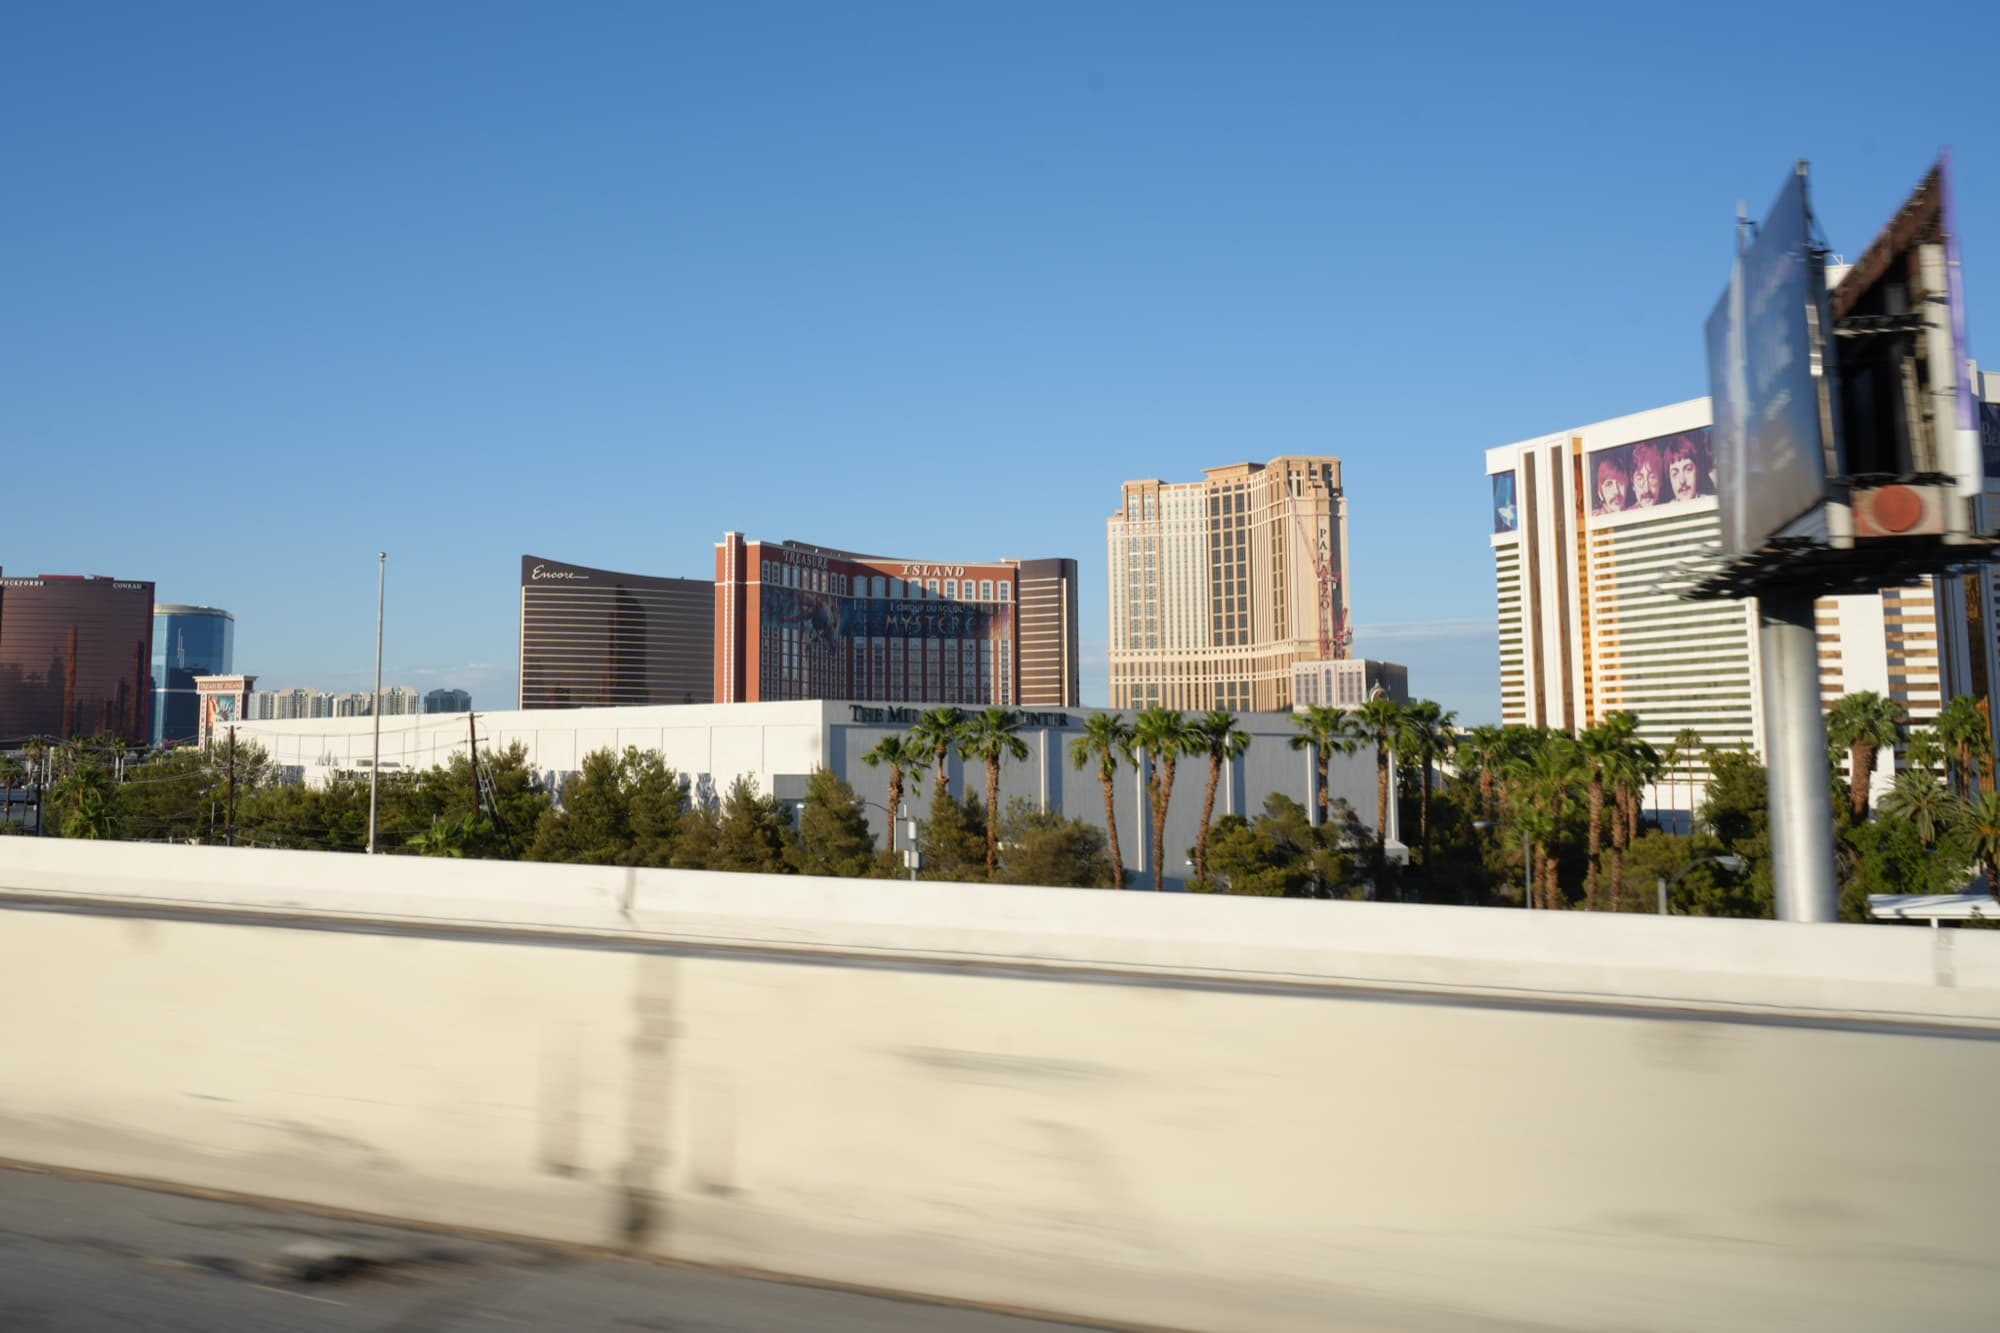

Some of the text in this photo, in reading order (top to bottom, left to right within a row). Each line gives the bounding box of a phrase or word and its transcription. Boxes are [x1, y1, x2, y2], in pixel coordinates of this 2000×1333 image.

[531, 564, 589, 580] Encore
[784, 551, 965, 577] TREASURE ISLAND
[1319, 528, 1330, 609] PALAZO
